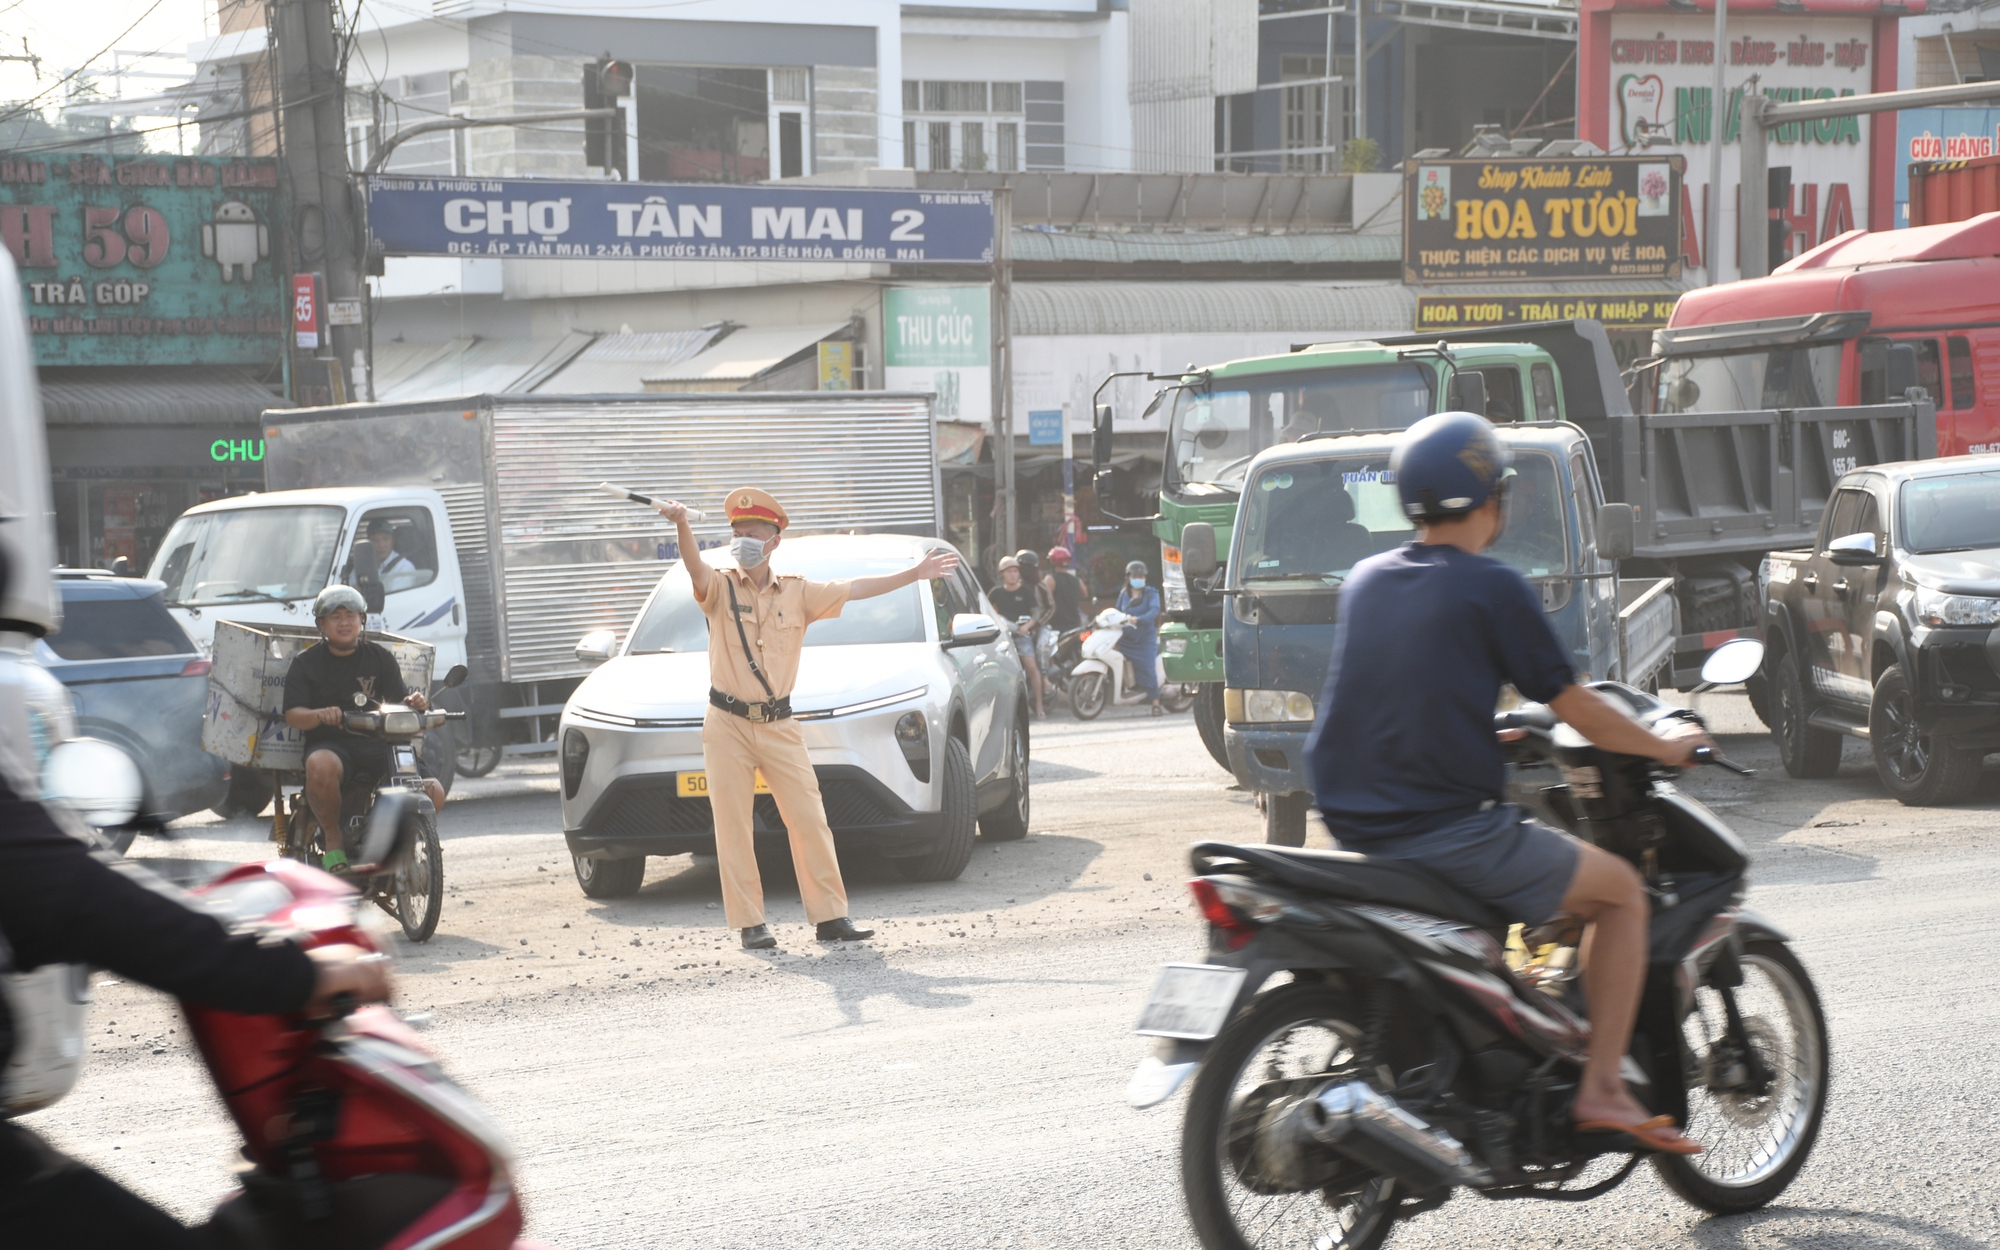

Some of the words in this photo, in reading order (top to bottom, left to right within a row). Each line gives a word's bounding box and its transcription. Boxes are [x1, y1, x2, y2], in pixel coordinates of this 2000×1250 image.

[1611, 31, 1677, 64] CHUYÊN
[1681, 40, 1726, 65] KHO
[1731, 36, 1777, 66] RĂNG
[1835, 38, 1868, 73] MẶT
[1911, 131, 1943, 158] CỬA
[1946, 132, 1991, 158] HÀNG
[1478, 165, 1518, 193] Shop
[1521, 165, 1571, 189] Khánh
[1574, 165, 1612, 188] Linh
[443, 197, 572, 242] CHỢ
[607, 196, 722, 238] TÂN
[751, 206, 863, 241] MAI
[890, 209, 925, 242] 2
[1454, 199, 1537, 240] HOA
[1545, 190, 1640, 238] TƯƠI
[83, 205, 169, 268] 59
[487, 239, 510, 255] ẤP
[516, 241, 552, 255] TÂN
[556, 243, 589, 255] MAI
[640, 242, 696, 257] PHƯỚC
[802, 244, 834, 259] HÒA
[843, 245, 886, 259] ĐỒNG
[897, 248, 924, 260] NAI
[1420, 249, 1460, 268] THỰC
[1465, 246, 1501, 267] HIỆN
[1507, 245, 1538, 264] CÁC
[1544, 247, 1580, 266] DỊCH
[1585, 246, 1606, 265] VỤ
[1635, 245, 1667, 260] HOA
[31, 277, 86, 304] TRẢ
[96, 279, 149, 304] GÓP
[297, 295, 312, 322] 5G
[1423, 305, 1458, 322] HOA
[1463, 302, 1503, 322] TƯƠI
[1520, 301, 1558, 320] TRÁI
[1563, 300, 1598, 320] CÂY
[1602, 300, 1649, 323] NHẬP
[897, 315, 932, 346] THU
[937, 306, 973, 346] CÚC
[210, 439, 265, 461] CHU
[1342, 465, 1377, 484] TUẤN
[687, 776, 708, 792] 50
